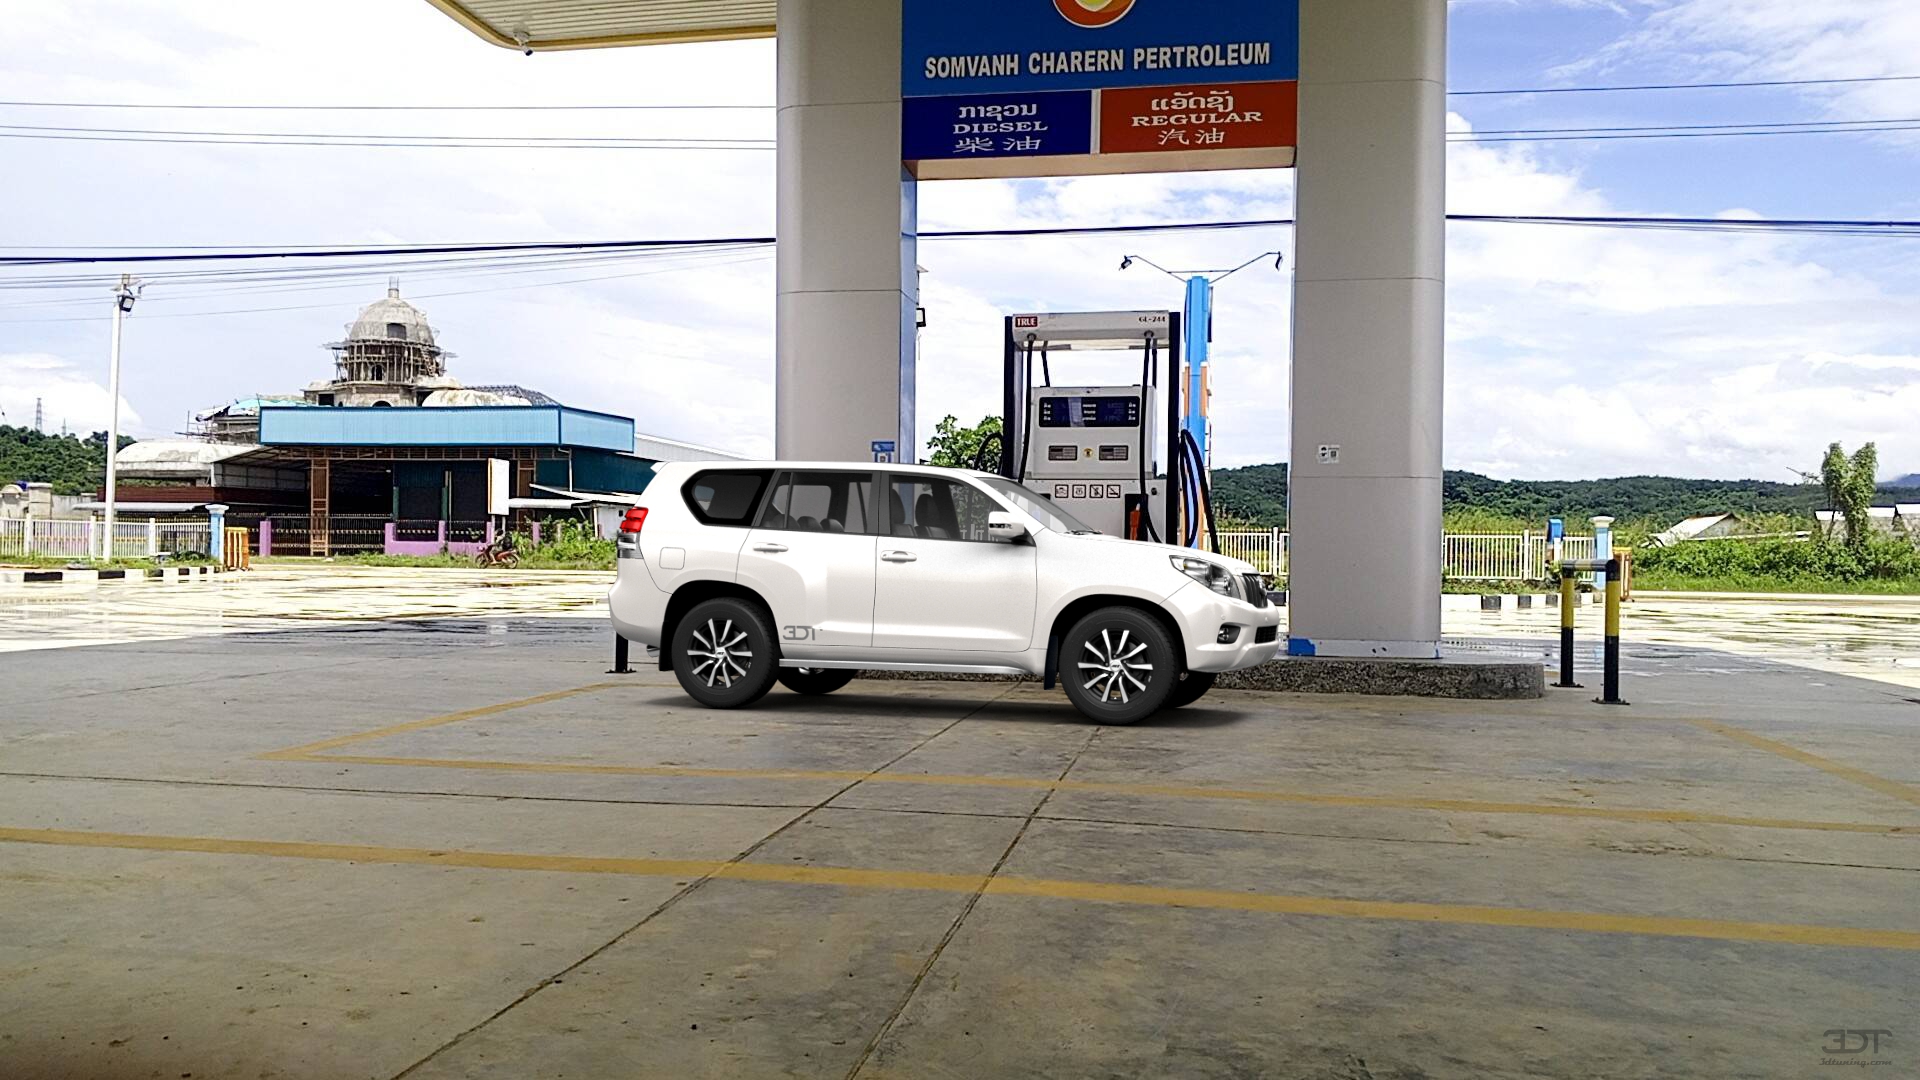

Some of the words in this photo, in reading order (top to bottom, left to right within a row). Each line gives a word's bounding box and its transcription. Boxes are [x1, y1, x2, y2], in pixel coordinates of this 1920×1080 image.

[925, 53, 1019, 79] SOMVANH
[1028, 49, 1124, 74] CHARERN
[1133, 42, 1271, 70] PERTROLEUM
[952, 120, 1049, 135] DIESEL
[1131, 111, 1264, 127] REGULAR
[952, 135, 1043, 153] 柴油
[1157, 127, 1225, 146] 汽油
[1016, 317, 1037, 327] TRUE
